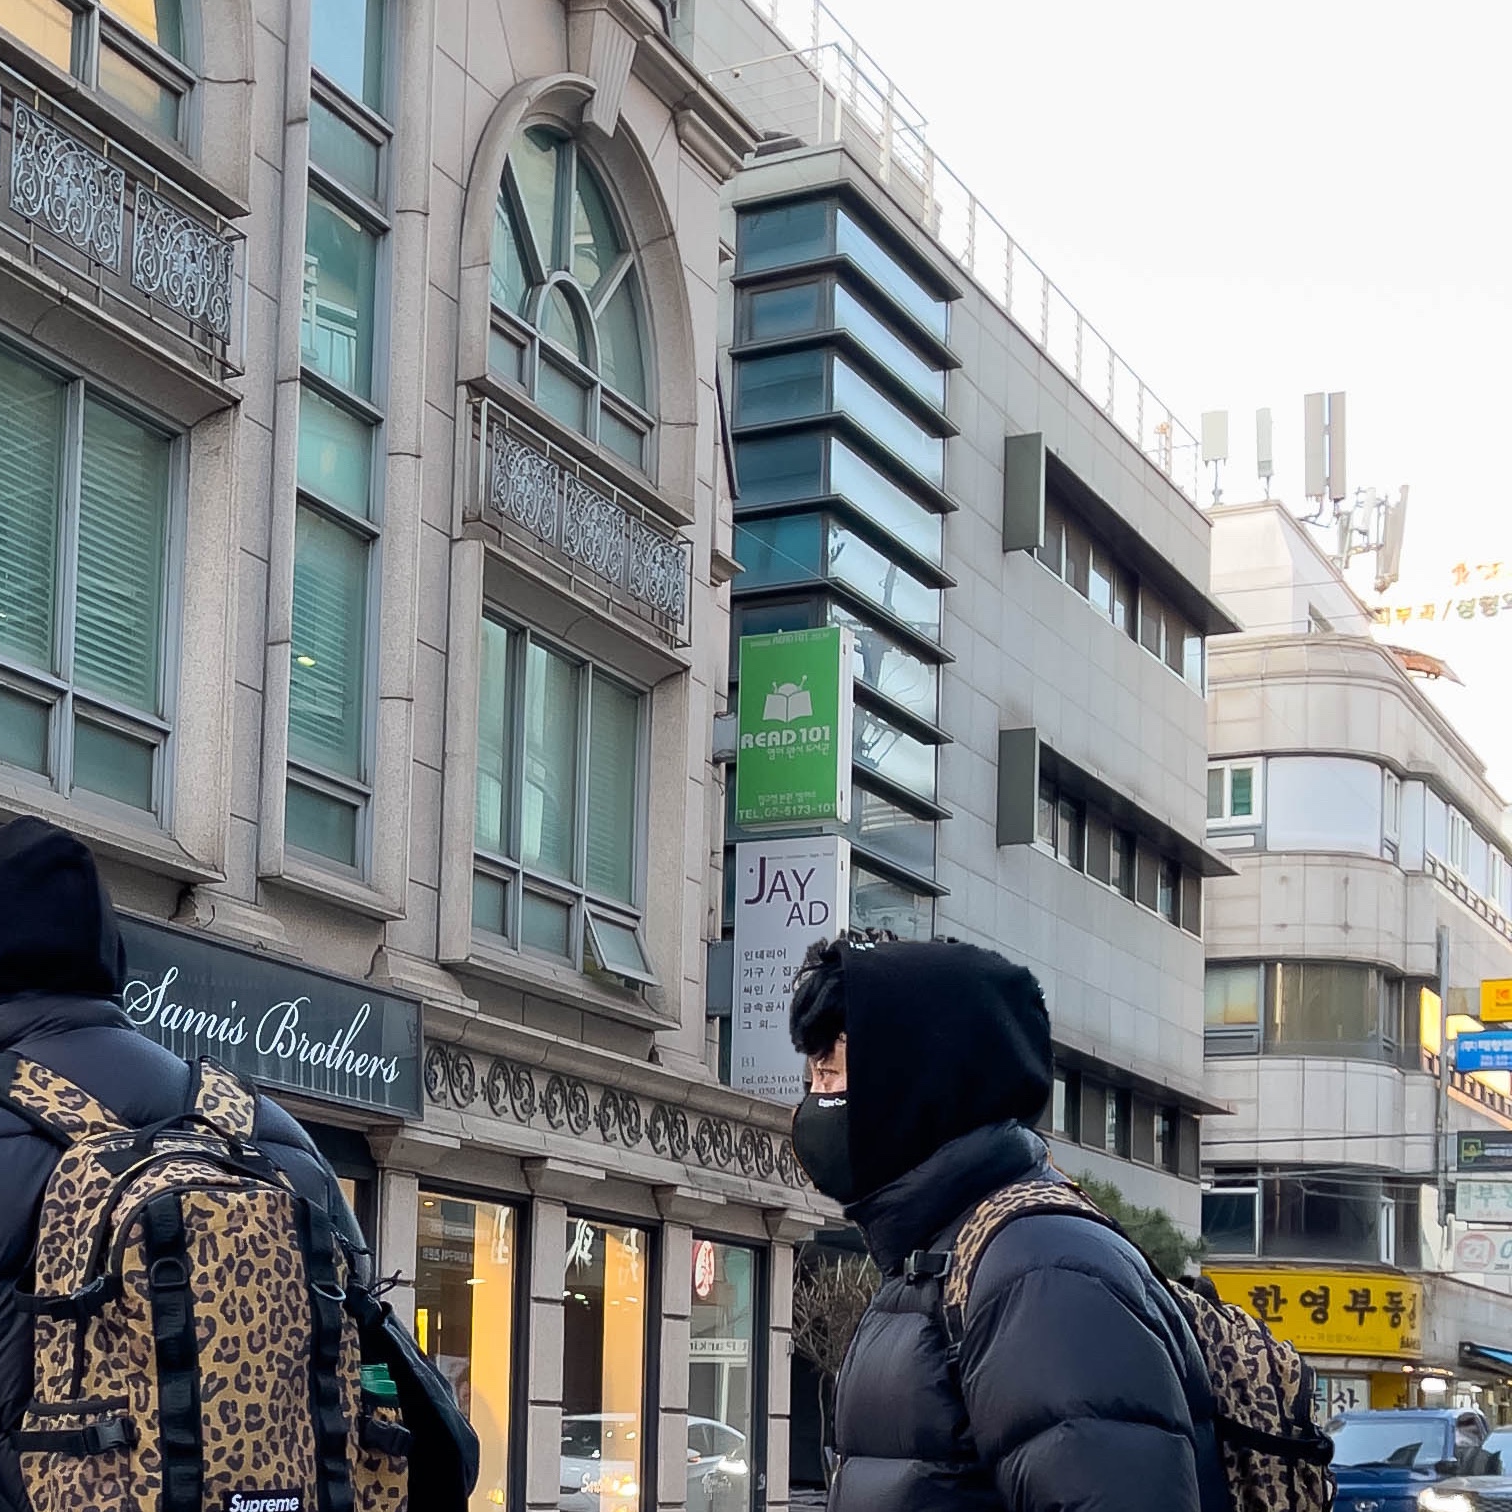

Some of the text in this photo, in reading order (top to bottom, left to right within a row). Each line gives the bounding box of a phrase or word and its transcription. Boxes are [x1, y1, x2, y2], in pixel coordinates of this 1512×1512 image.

[740, 725, 830, 750] READ 101
[744, 856, 816, 905] JAY
[785, 900, 829, 927] AD
[743, 948, 787, 961] 인테리어
[122, 966, 401, 1084] Samis Brothers
